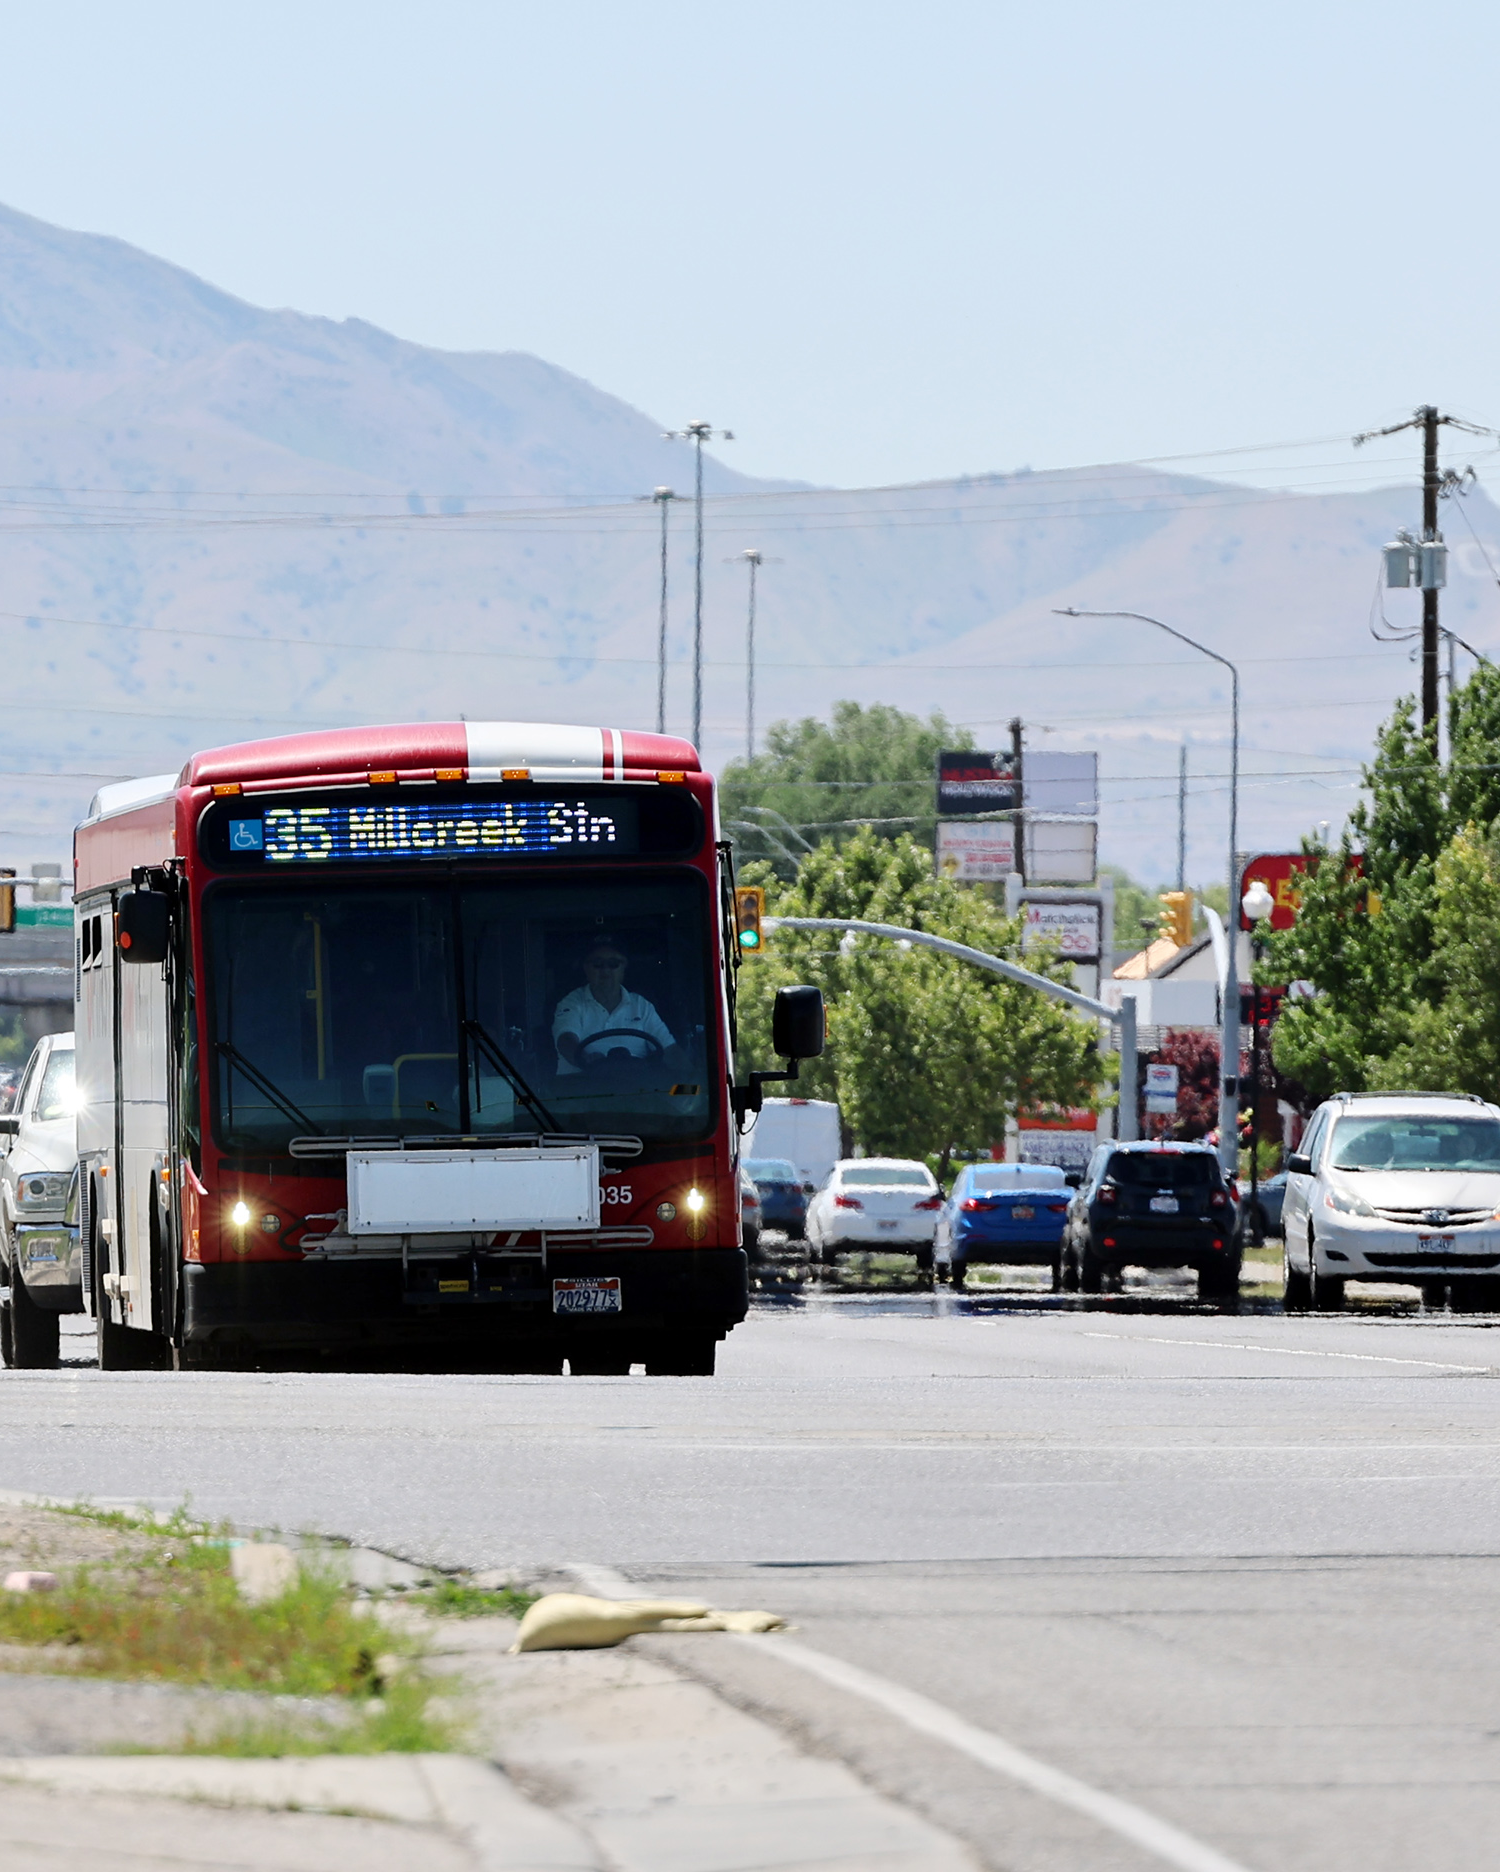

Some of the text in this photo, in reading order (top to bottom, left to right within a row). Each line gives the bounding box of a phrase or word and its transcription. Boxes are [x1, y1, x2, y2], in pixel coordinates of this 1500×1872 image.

[264, 801, 615, 859] 35 Millcreek Stn
[558, 1290, 607, 1307] 202977
